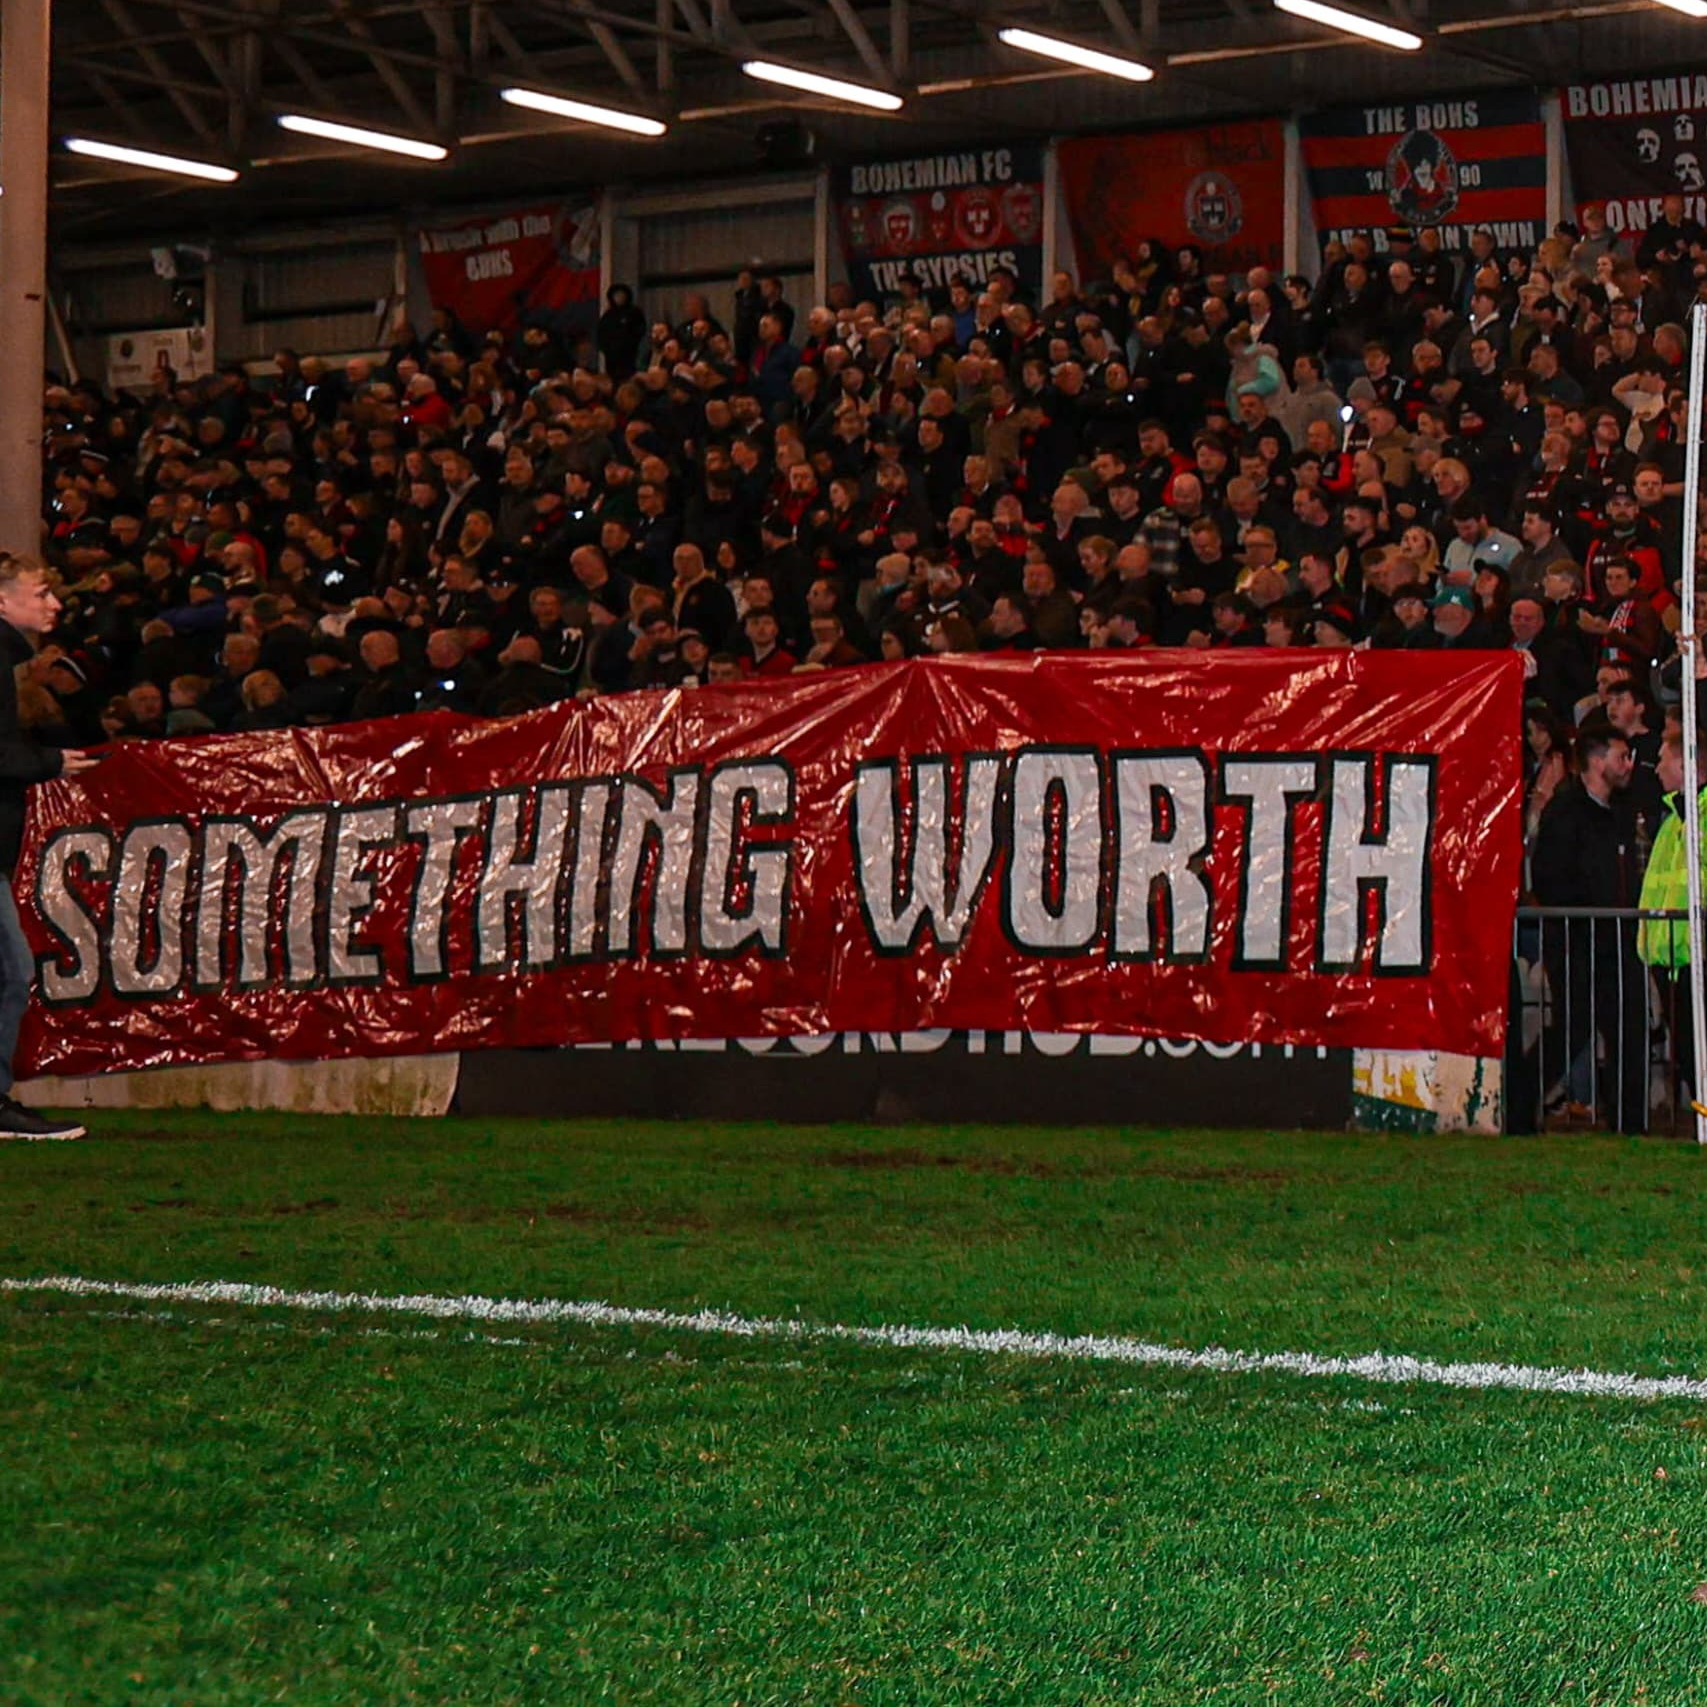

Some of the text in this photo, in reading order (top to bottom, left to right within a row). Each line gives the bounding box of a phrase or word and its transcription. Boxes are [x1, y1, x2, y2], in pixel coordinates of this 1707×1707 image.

[1363, 101, 1480, 135] THE BOHS
[851, 149, 1012, 194] BOHEMIAN FC
[1459, 164, 1481, 186] 90
[36, 744, 1438, 1005] SOMETHING WORTH
